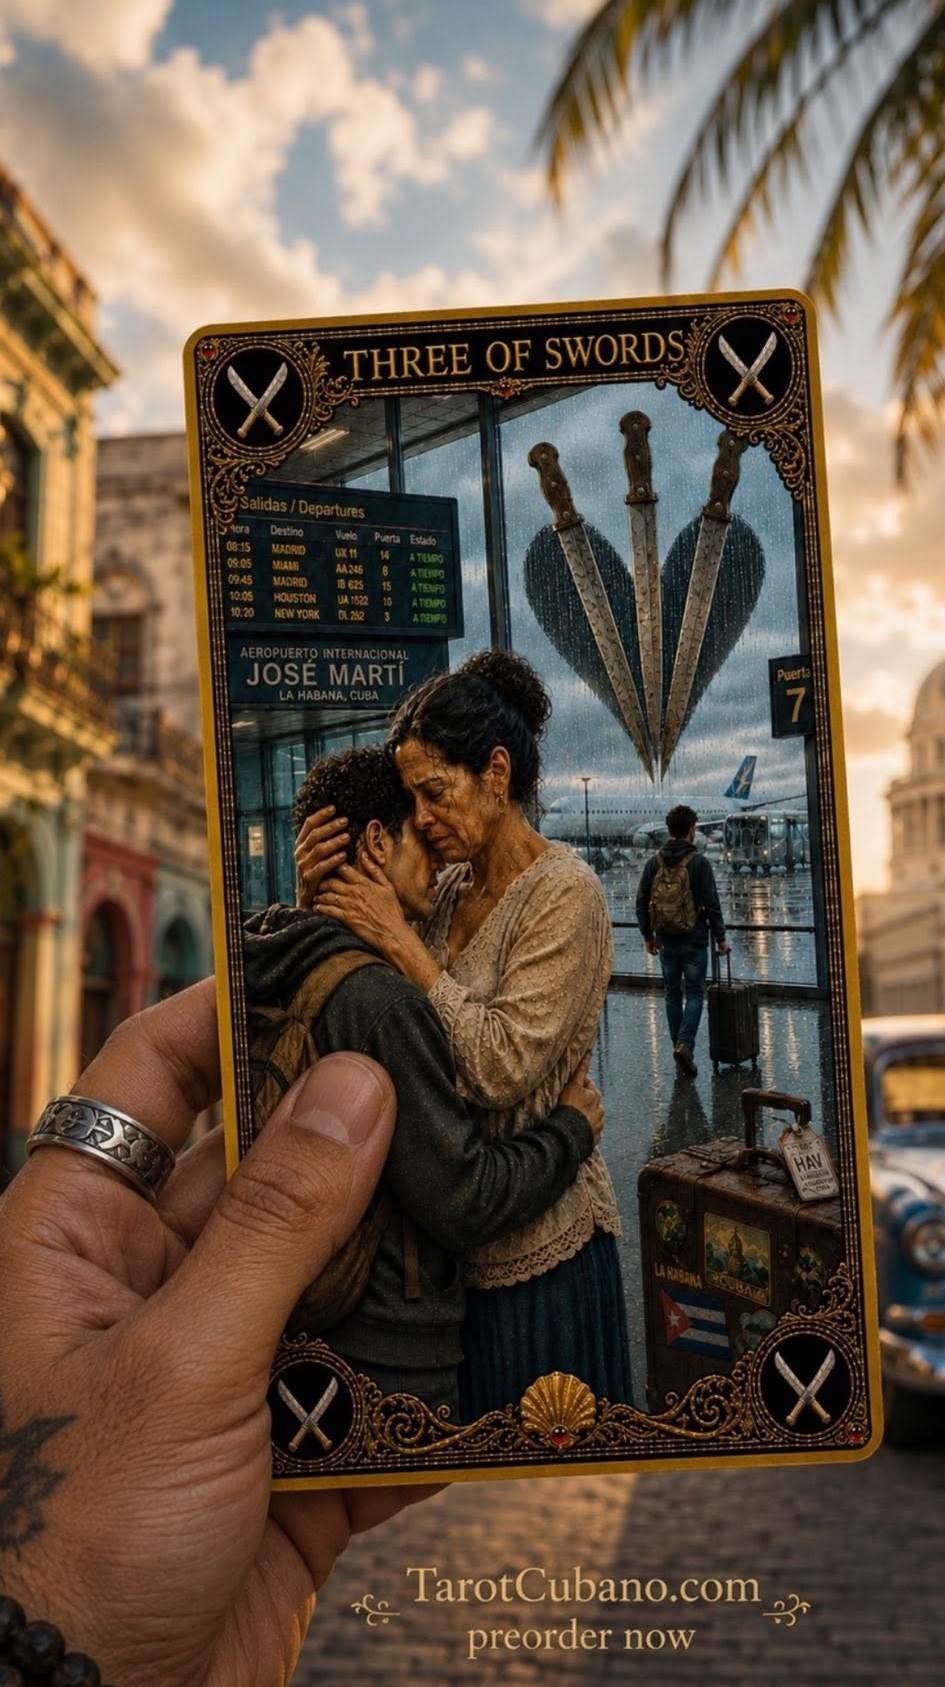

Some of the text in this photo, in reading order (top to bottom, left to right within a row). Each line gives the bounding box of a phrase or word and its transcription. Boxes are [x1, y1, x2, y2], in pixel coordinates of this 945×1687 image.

[344, 329, 685, 382] THREE OF SWORDS
[240, 495, 287, 512] Salidas
[299, 499, 365, 519] Departures
[270, 524, 304, 537] Destino
[335, 530, 358, 541] Vuelo
[374, 532, 401, 544] Puerta
[410, 534, 437, 546] Estado
[226, 541, 251, 553] 08:15
[271, 543, 306, 556] MADRID
[349, 548, 357, 559] 11
[227, 557, 252, 569] 09:05
[272, 560, 300, 571] MIAMI
[272, 576, 308, 588] MADRID
[382, 581, 392, 592] 15
[273, 592, 317, 604] HOUSTON
[274, 608, 294, 619] NEW
[296, 608, 320, 620] YORK
[384, 612, 391, 622] 3
[240, 647, 410, 661] AEROPUERTO INTERNACIONAL
[246, 659, 405, 687] JOSÉ MARTÍ
[777, 666, 812, 682] Puerta
[279, 690, 380, 702] LA HABANA, CUBA
[786, 686, 807, 724] 7
[793, 1152, 823, 1173] HAV
[654, 1261, 666, 1279] LA
